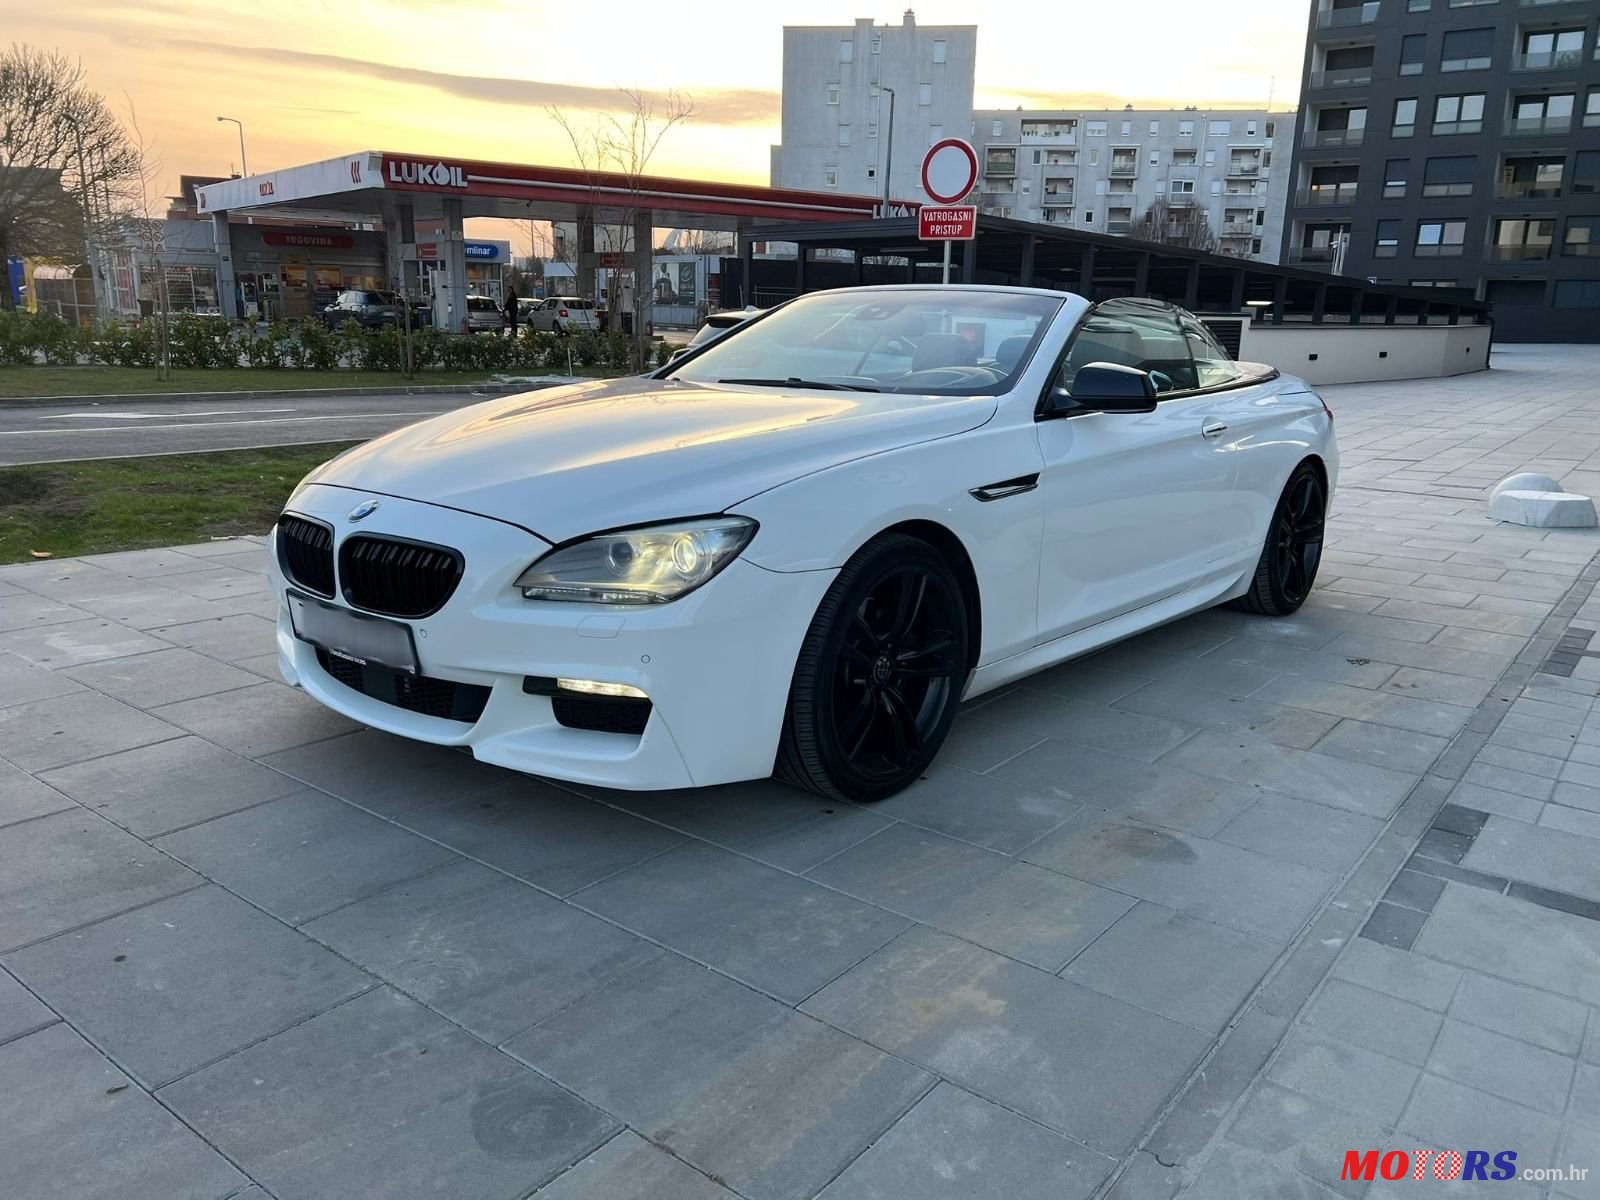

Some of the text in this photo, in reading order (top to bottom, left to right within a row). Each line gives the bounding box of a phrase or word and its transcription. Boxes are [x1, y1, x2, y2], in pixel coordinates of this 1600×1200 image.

[389, 161, 468, 187] LUKOIL
[923, 210, 972, 222] VATROGASNI
[930, 224, 963, 235] PRISTUP
[466, 246, 491, 255] mlinar
